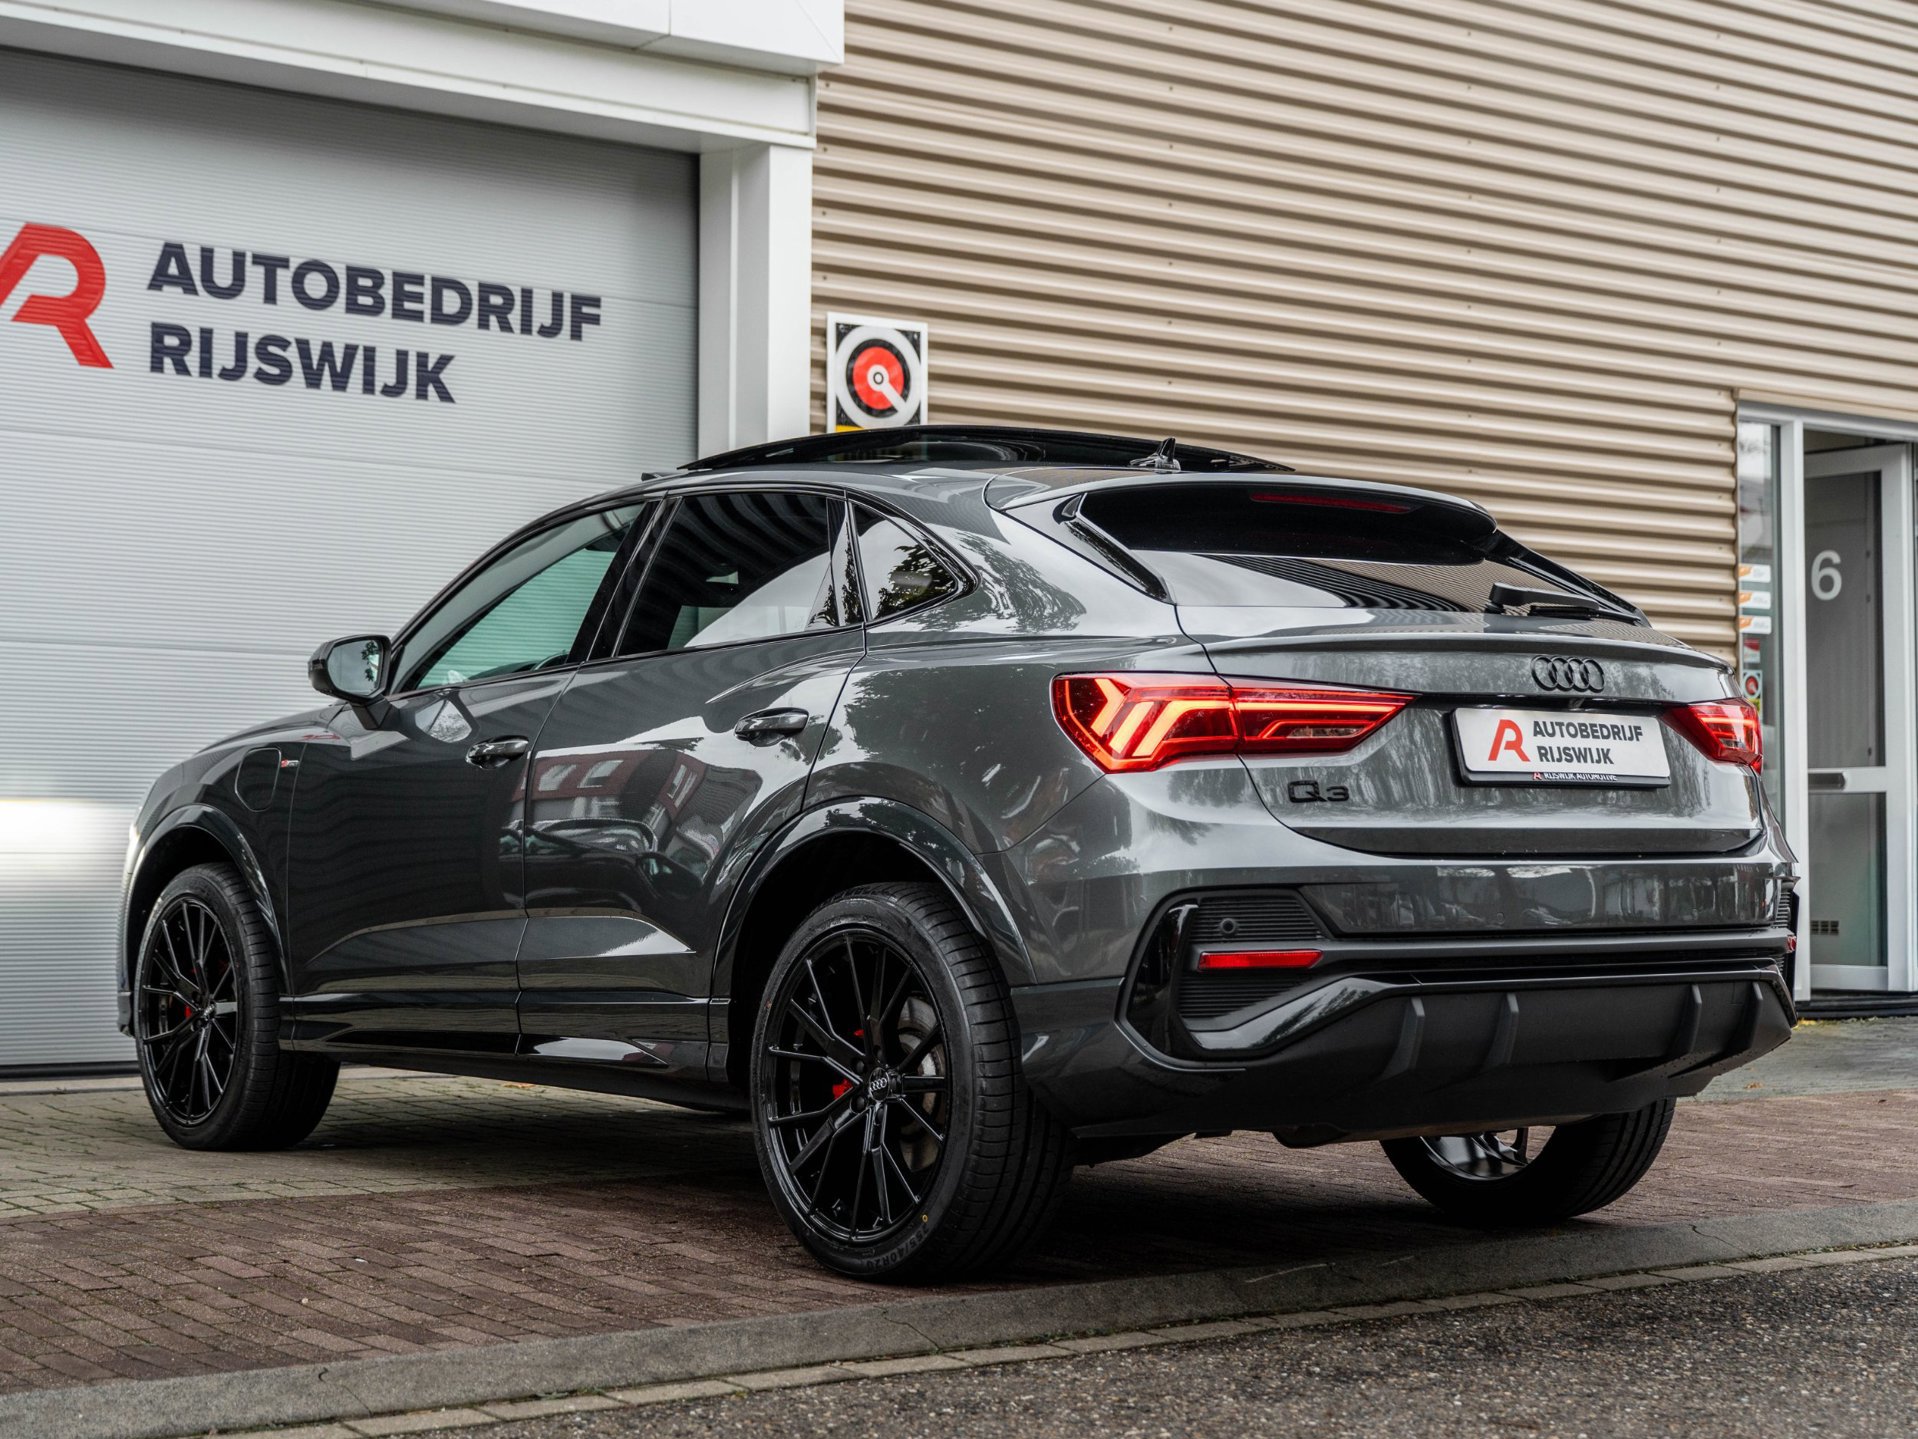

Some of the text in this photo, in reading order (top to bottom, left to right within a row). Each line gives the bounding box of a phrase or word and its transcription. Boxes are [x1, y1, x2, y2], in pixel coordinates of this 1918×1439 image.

[147, 242, 602, 342] AUTOBEDRIJF
[149, 322, 456, 404] RIJSWIJK
[1811, 550, 1843, 601] 6
[1532, 720, 1644, 742] AUTOBEDRIJF
[1536, 746, 1614, 765] RIJSWIJK
[1288, 780, 1350, 803] Q3
